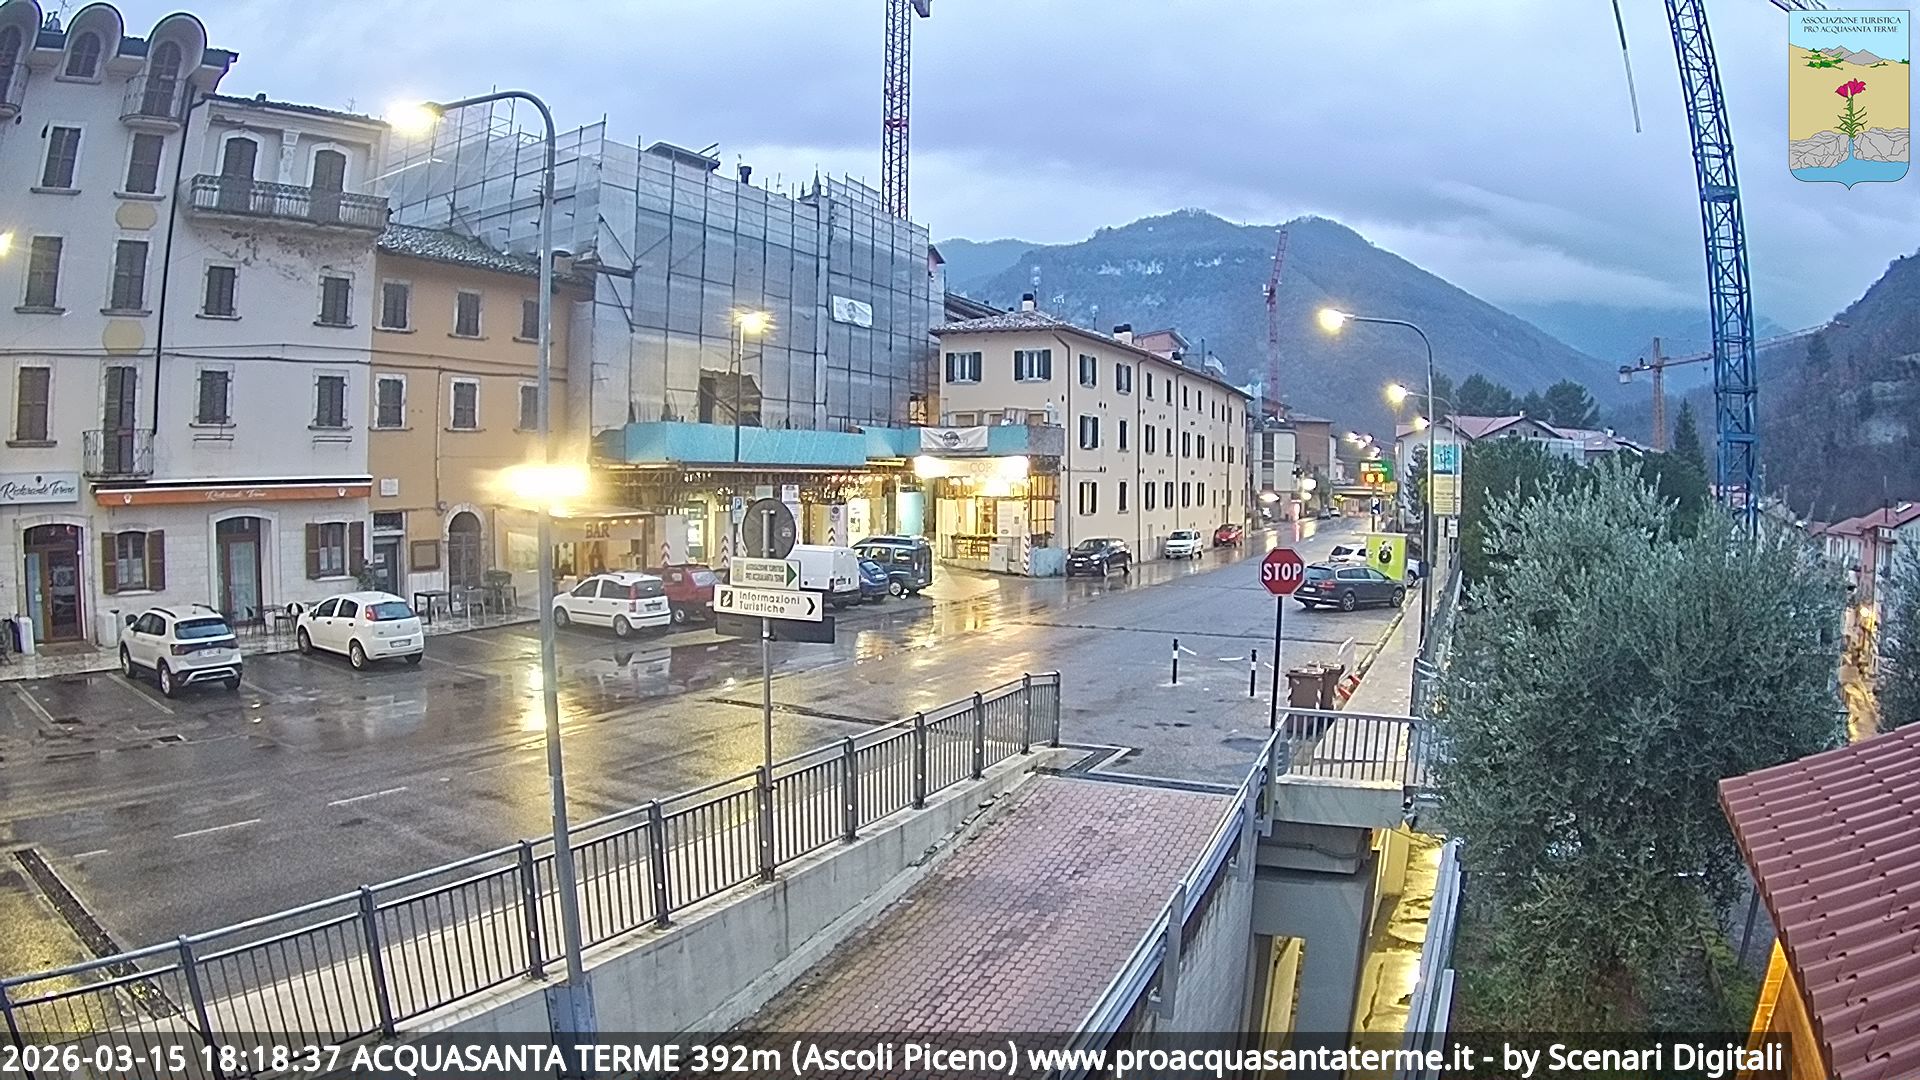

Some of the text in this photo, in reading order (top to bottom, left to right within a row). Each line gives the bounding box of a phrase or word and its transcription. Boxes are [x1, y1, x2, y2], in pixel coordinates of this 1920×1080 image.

[585, 523, 610, 539] BAR
[1263, 562, 1302, 581] STOP
[739, 591, 800, 605] Informazioni
[739, 601, 785, 614] Turistiche
